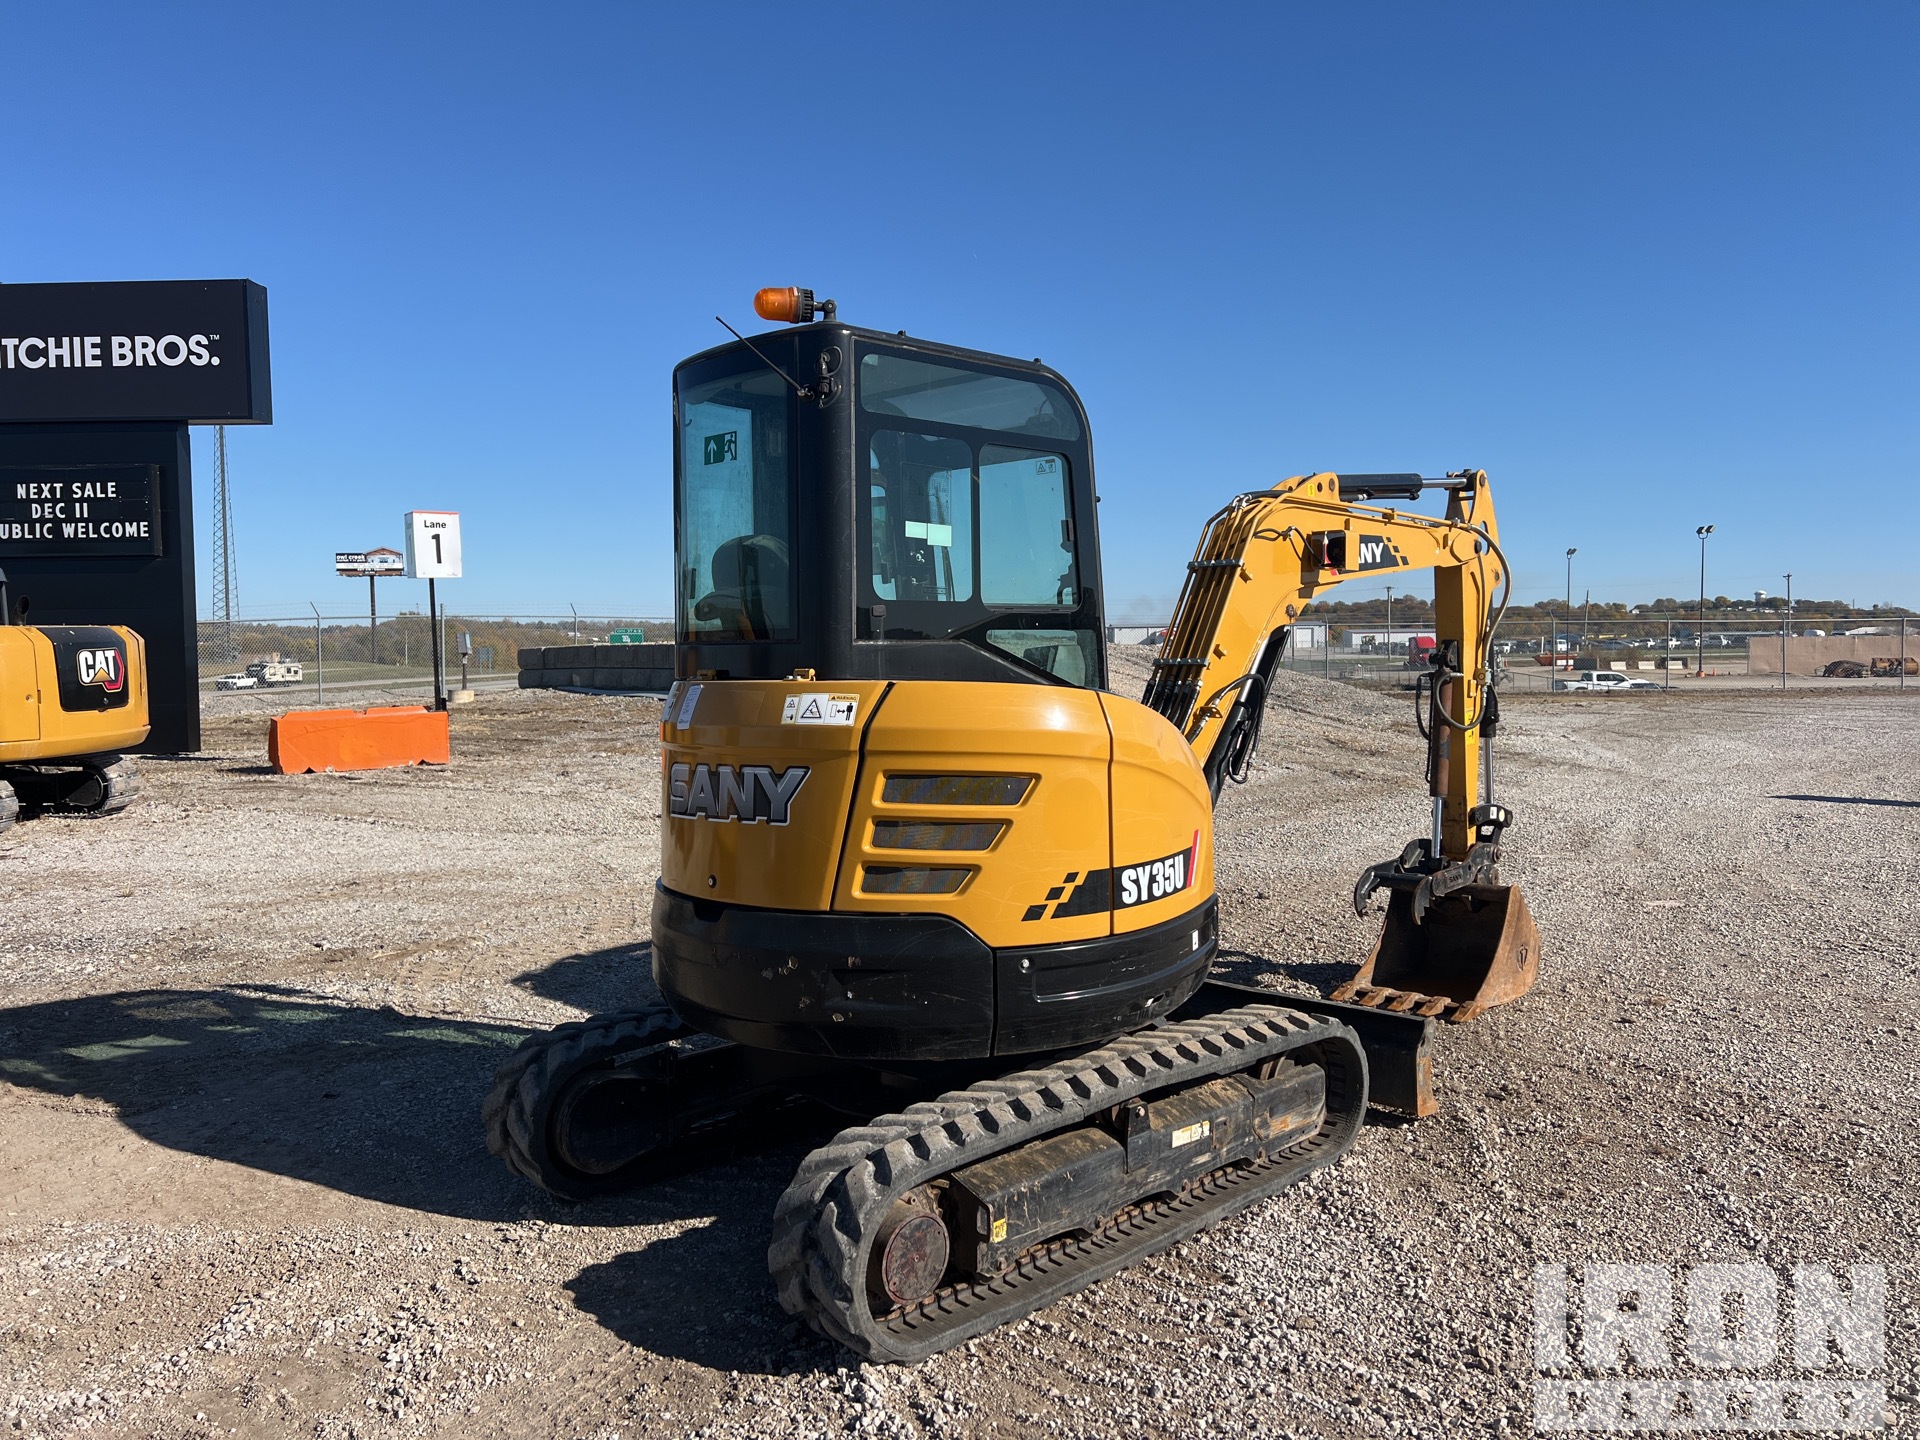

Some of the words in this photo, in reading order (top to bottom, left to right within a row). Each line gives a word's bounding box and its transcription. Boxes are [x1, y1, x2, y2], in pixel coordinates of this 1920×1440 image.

[0, 336, 103, 369] TCHIE
[17, 482, 64, 499] NEXT
[72, 481, 117, 498] SALE
[31, 502, 66, 519] DEC
[62, 521, 150, 539] WELCOME
[424, 519, 447, 529] Lane
[431, 533, 442, 564] 1
[1358, 542, 1384, 564] NY
[78, 649, 116, 683] CAT
[670, 763, 811, 825] SANY
[1121, 854, 1184, 905] SY35U
